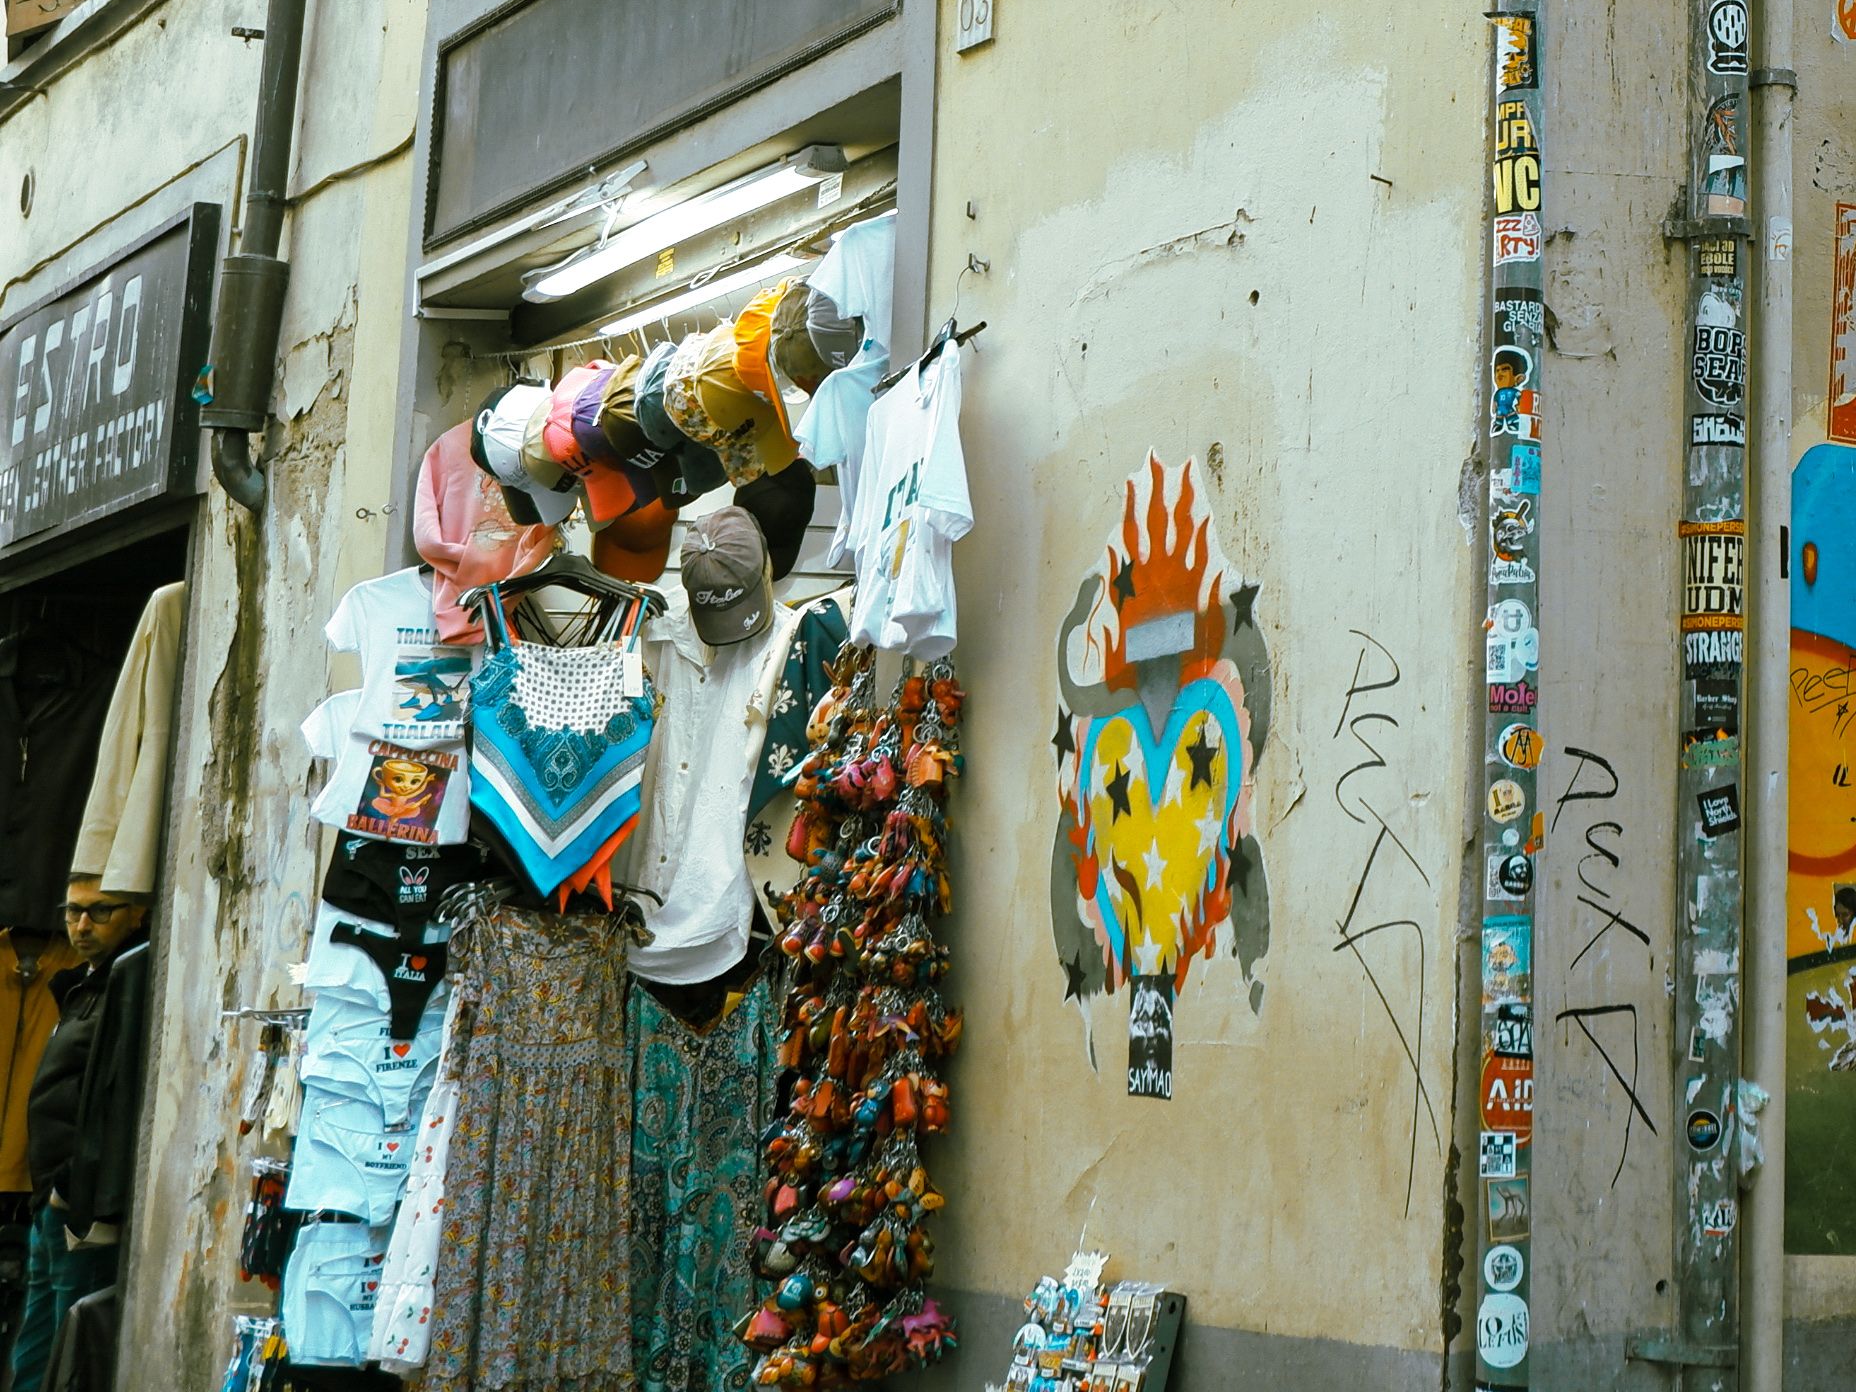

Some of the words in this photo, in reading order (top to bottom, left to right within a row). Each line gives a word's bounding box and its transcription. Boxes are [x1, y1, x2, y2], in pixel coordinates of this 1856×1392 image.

[11, 273, 143, 449] ESTRO
[93, 398, 168, 485] FACTORY
[345, 813, 440, 845] BALLERINA
[405, 845, 440, 860] SEX
[399, 886, 413, 895] ALL
[413, 885, 428, 894] YOU
[399, 894, 414, 904] CAN
[415, 893, 427, 903] EAT
[394, 968, 427, 982] ITALIA
[384, 1046, 392, 1061] I
[375, 1059, 420, 1073] FIRENZE
